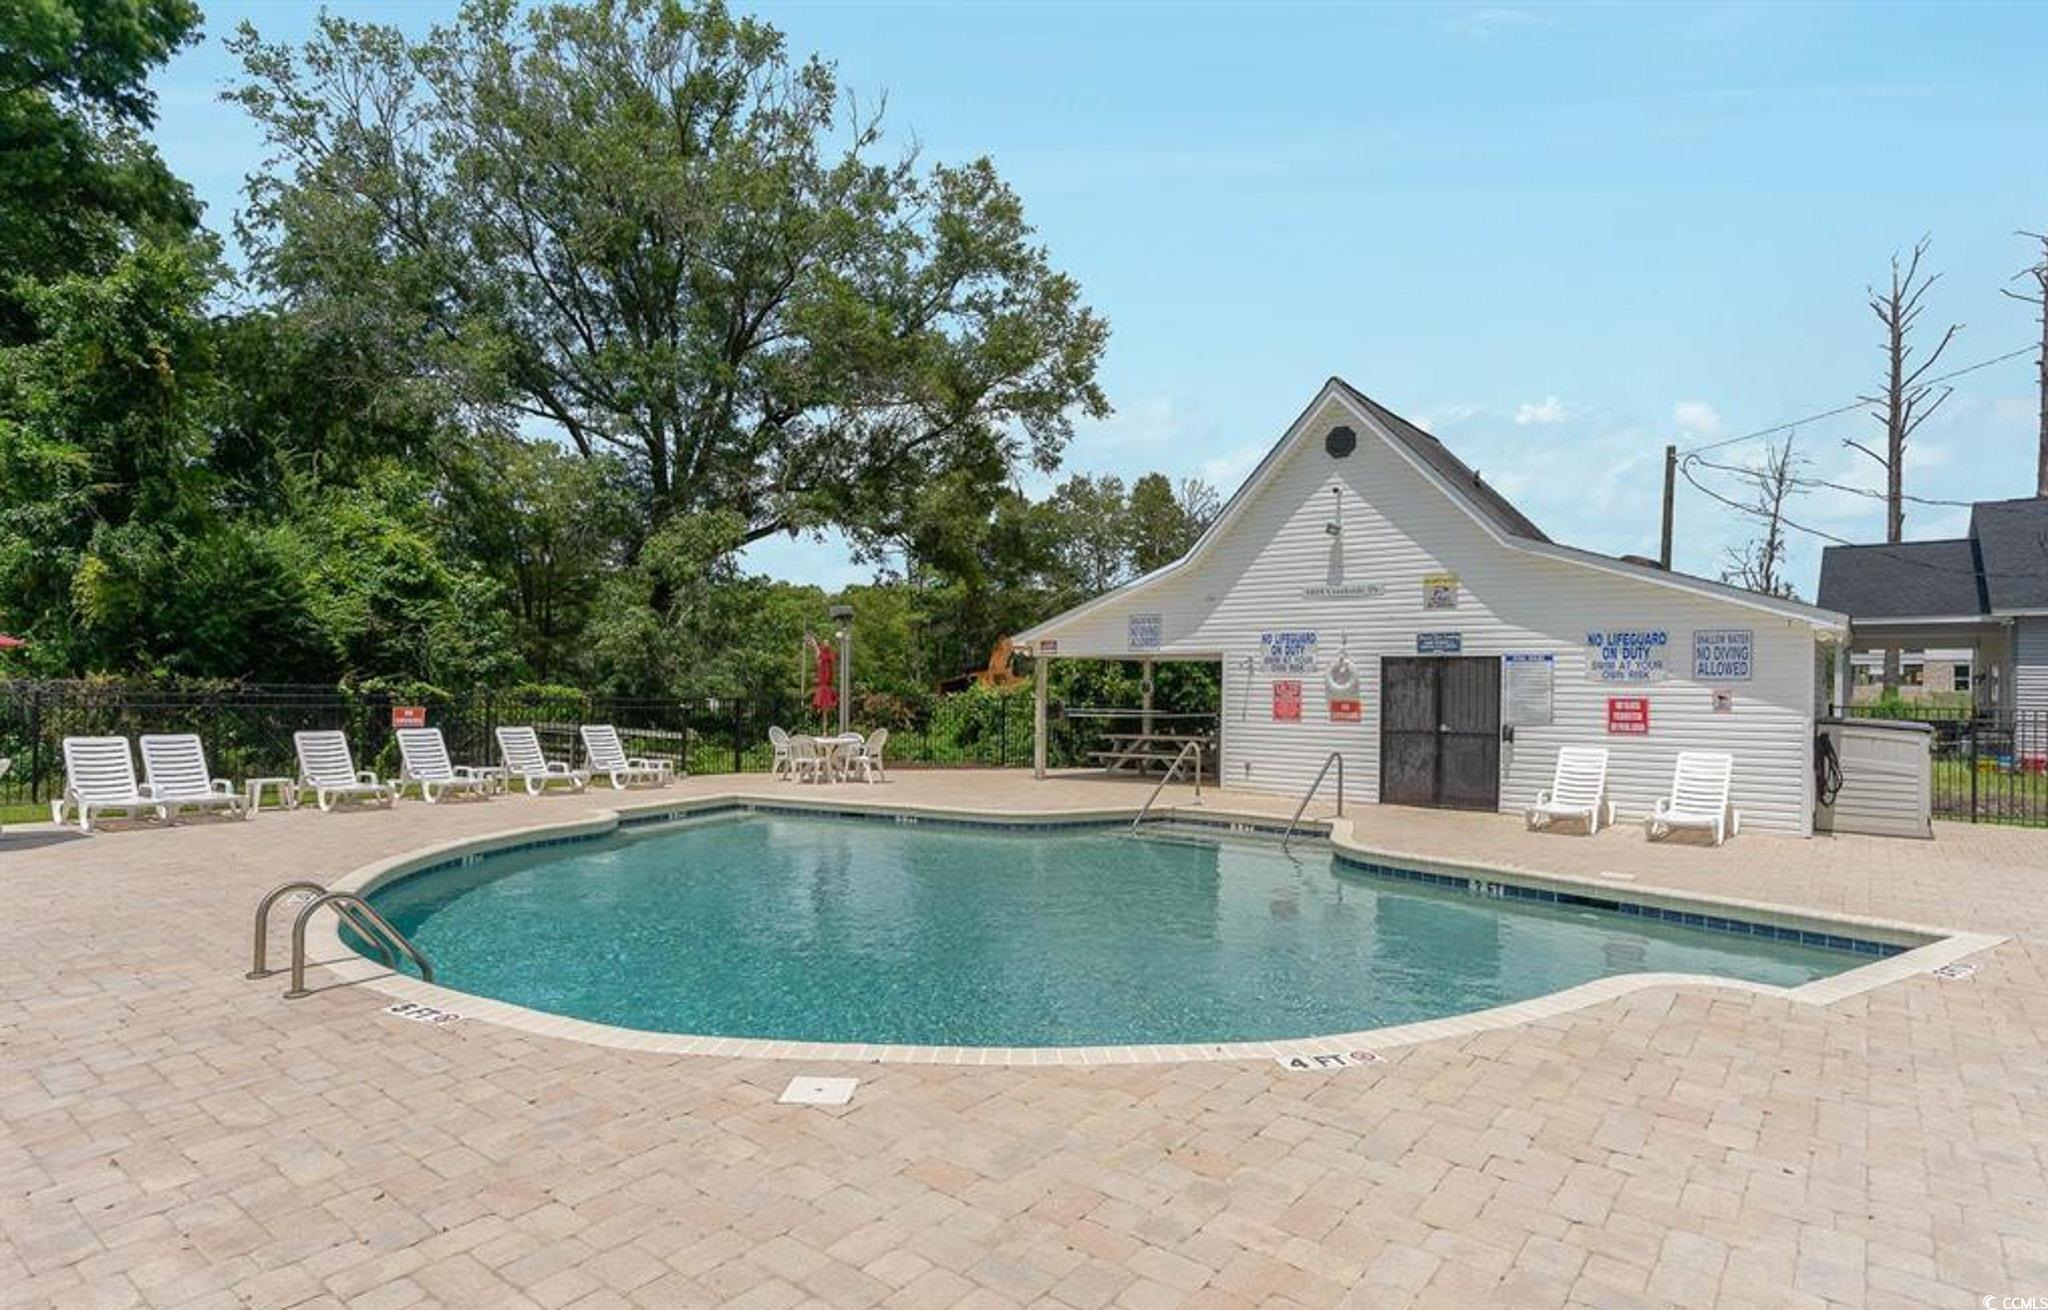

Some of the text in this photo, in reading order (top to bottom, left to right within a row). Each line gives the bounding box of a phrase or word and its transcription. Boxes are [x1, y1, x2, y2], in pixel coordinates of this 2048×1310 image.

[1275, 631, 1316, 645] LIFEGUARD
[1587, 631, 1667, 647] NO LIFEGUARD
[1271, 645, 1305, 656] ON DUTY
[1602, 646, 1650, 660] ON DUTY
[1697, 645, 1748, 660] NO DIVING
[1698, 661, 1748, 676] ALLOWED
[1290, 1053, 1347, 1069] 4 FT
